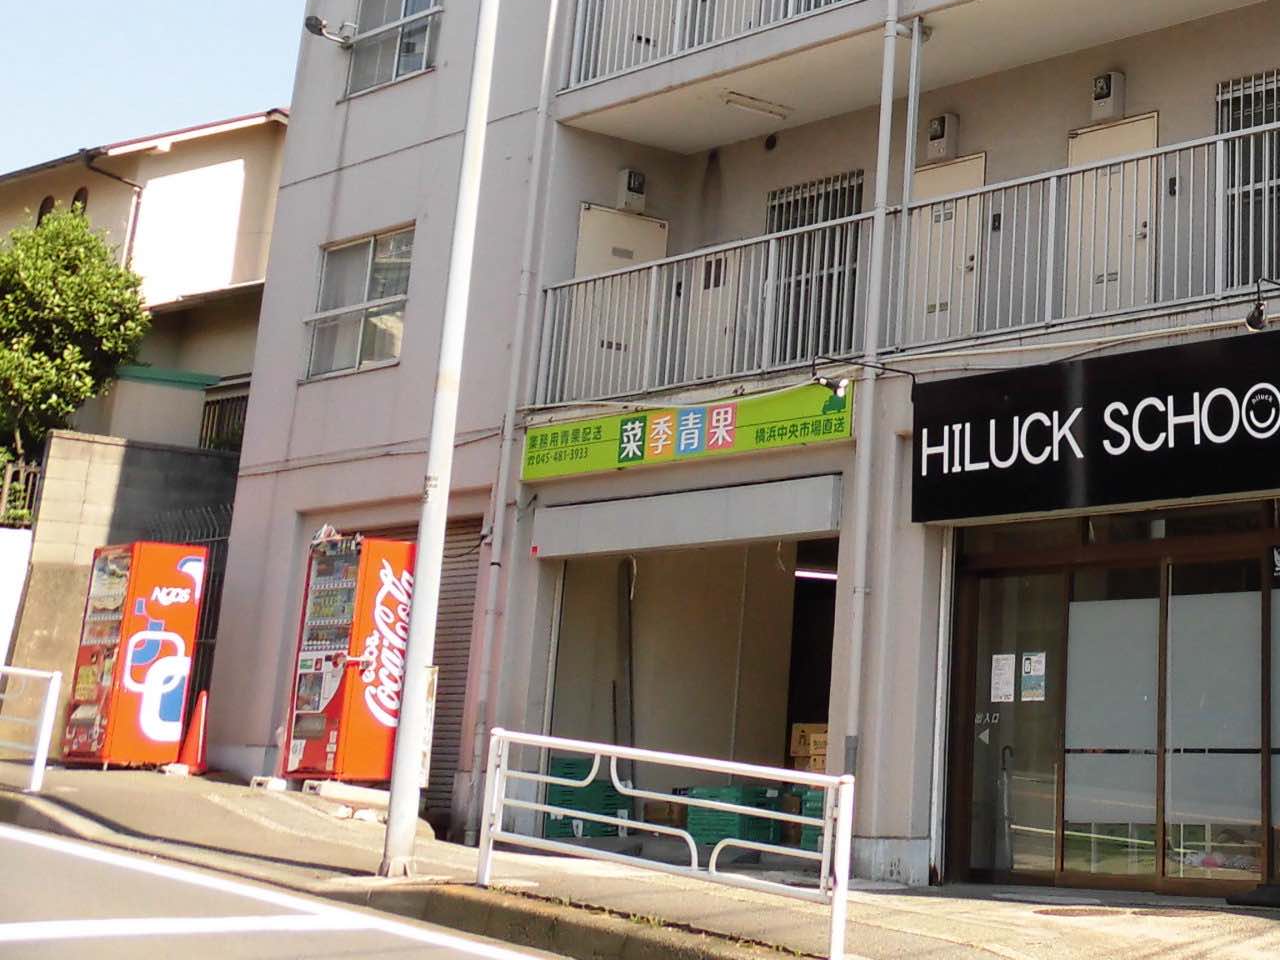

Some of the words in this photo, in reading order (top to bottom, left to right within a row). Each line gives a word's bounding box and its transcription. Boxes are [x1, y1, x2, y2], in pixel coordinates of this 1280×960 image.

[619, 404, 735, 460] 菜季青果
[755, 416, 845, 444] 横浜中央市場直送
[921, 406, 1085, 476] HILUCK
